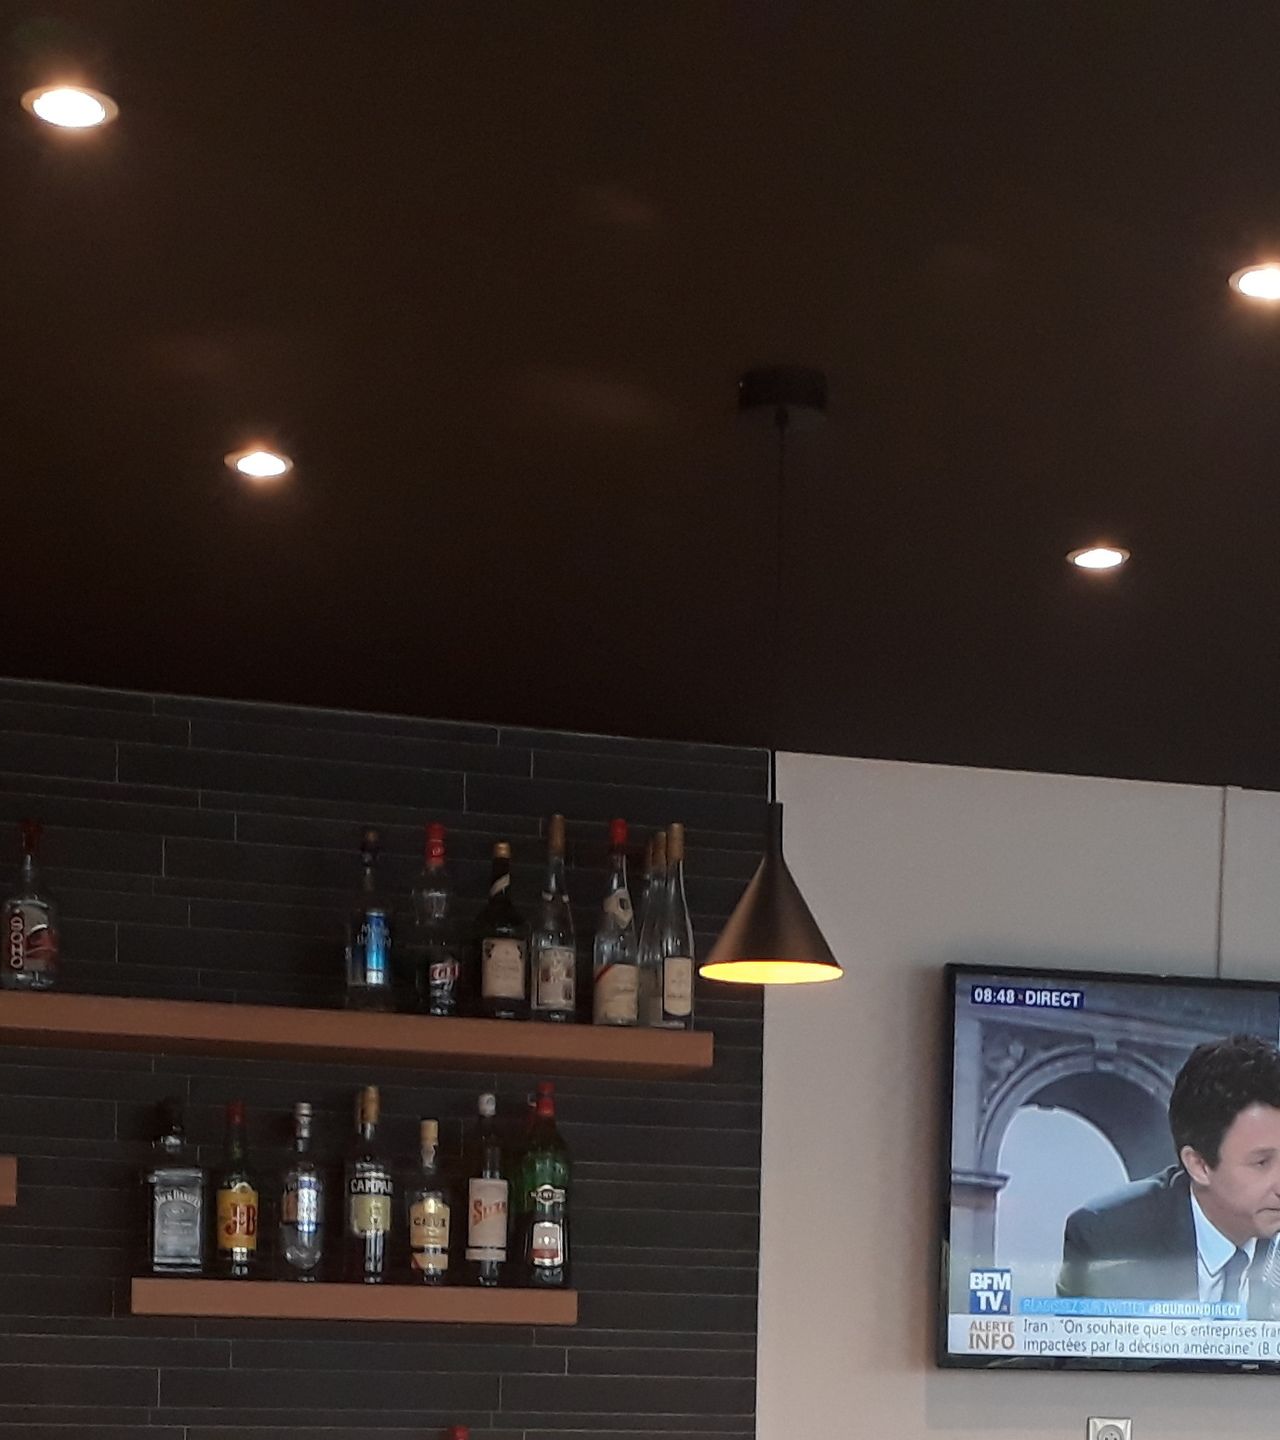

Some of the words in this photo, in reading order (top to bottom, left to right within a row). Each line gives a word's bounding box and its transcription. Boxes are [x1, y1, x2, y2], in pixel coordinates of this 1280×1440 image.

[10, 915, 24, 970] SOHO
[974, 987, 1015, 1004] 08:48
[1025, 990, 1081, 1008] DIRECT
[970, 1272, 1010, 1290] BFM
[970, 1321, 1014, 1332] ALERTE
[1024, 1318, 1048, 1333] Iran
[1087, 1320, 1139, 1335] souhaite
[1144, 1324, 1166, 1338] que
[1171, 1321, 1186, 1336] les
[1191, 1325, 1257, 1340] entreprises
[969, 1333, 1014, 1350] INFO
[1023, 1338, 1086, 1355] impactées
[1091, 1341, 1110, 1355] par
[1115, 1339, 1124, 1353] la
[1129, 1340, 1179, 1354] décision
